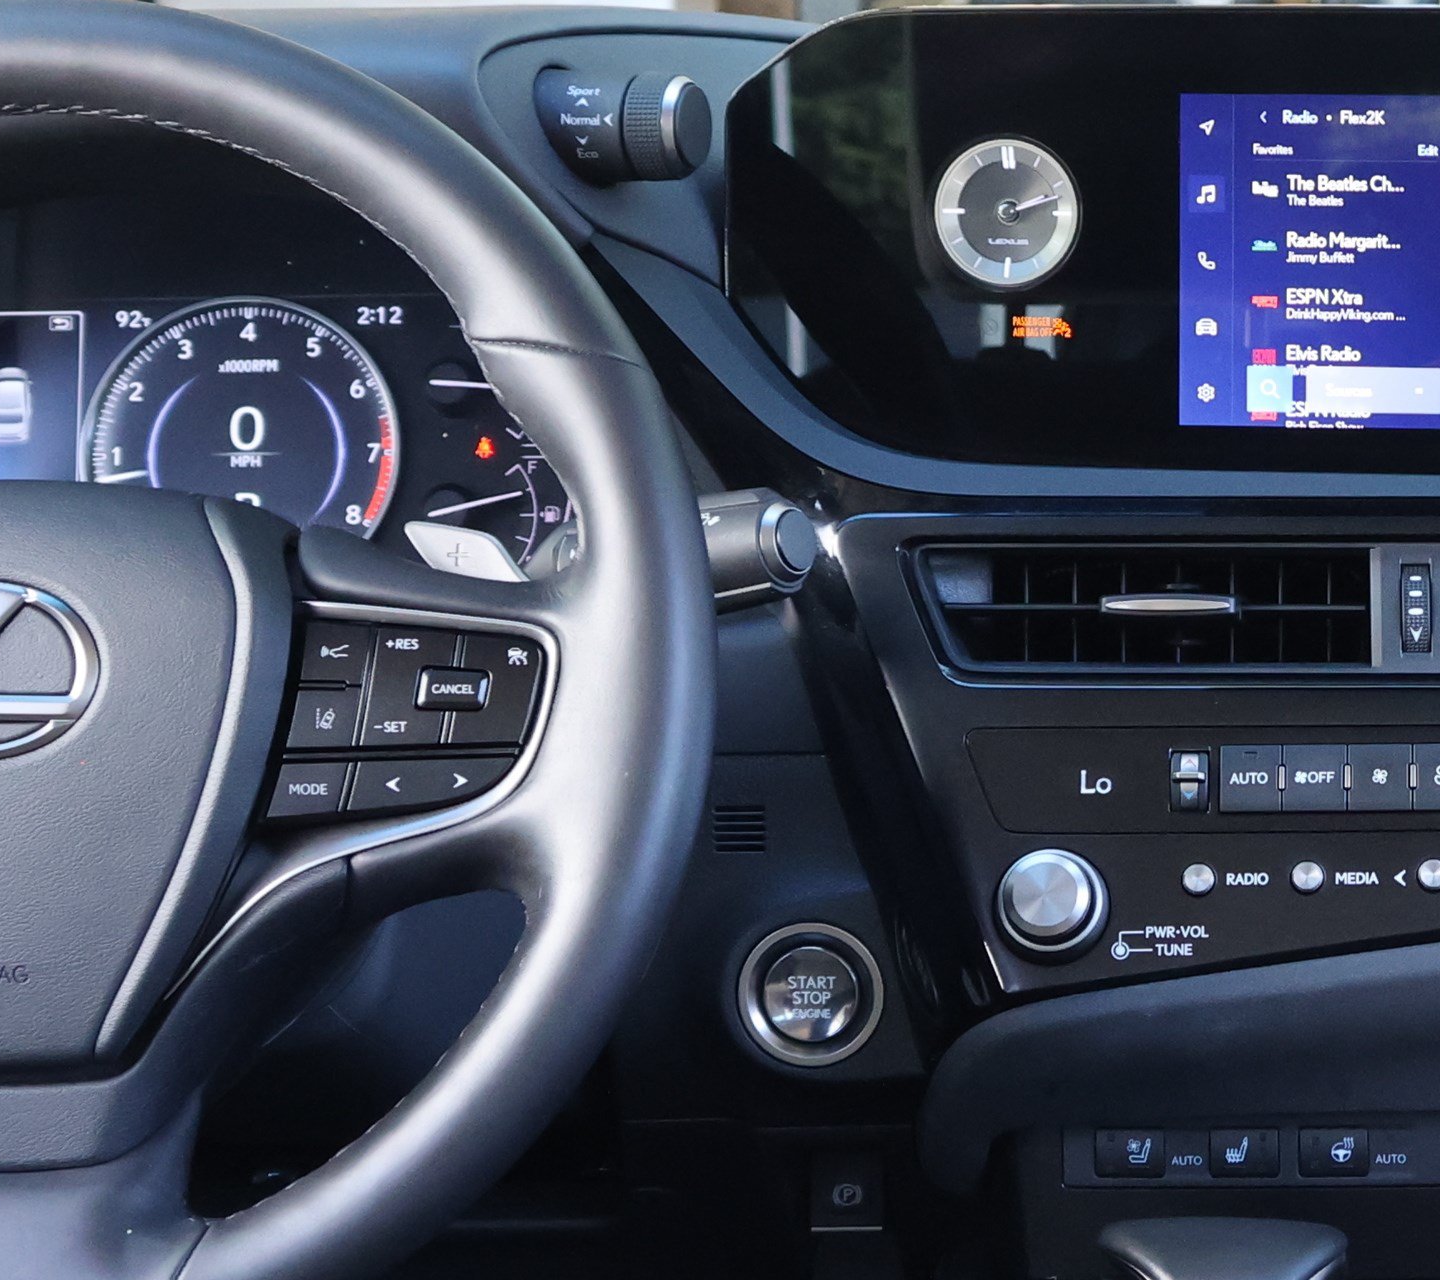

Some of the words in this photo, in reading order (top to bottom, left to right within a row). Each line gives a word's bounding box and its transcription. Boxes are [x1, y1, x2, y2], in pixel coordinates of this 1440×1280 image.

[566, 84, 602, 98] Sport
[560, 112, 601, 126] Normal
[1282, 109, 1319, 124] Radio
[1340, 109, 1386, 125] Flex2K
[1252, 143, 1294, 156] Favorites
[1417, 143, 1439, 157] Edit
[1286, 174, 1315, 192] The
[1317, 174, 1368, 192] Beatles
[1287, 194, 1307, 207] The
[1308, 194, 1344, 207] Beatles
[987, 237, 1030, 246] LEXUS
[1286, 231, 1327, 248] Radio
[1286, 252, 1318, 265] Jimmy
[1319, 252, 1355, 264] Buffett
[1286, 287, 1330, 305] ESPN
[1330, 288, 1363, 306] Xtra
[356, 306, 404, 326] 2:12
[1012, 316, 1051, 327] PASSENGER
[1286, 308, 1394, 323] DrinkHappyViking.com
[239, 322, 258, 342] 4
[177, 341, 194, 360] 3
[306, 338, 322, 357] 5
[1286, 344, 1319, 361] Elvis
[1320, 345, 1362, 362] Radio
[218, 359, 279, 373] x1000RPM
[128, 382, 144, 402] 2
[348, 378, 365, 399] 6
[229, 405, 266, 451] 0
[111, 446, 123, 466] 1
[366, 442, 381, 463] 7
[230, 456, 263, 468] MPH
[527, 461, 538, 474] F
[345, 504, 362, 525] 8
[431, 682, 475, 696] CANCEL
[1079, 768, 1113, 795] Lo
[1229, 771, 1269, 785] AUTO
[1307, 770, 1335, 784] OFF
[288, 782, 328, 796] MODE
[1226, 872, 1269, 887] RADIO
[1335, 871, 1379, 886] MEDIA
[1155, 943, 1193, 957] TUNE
[787, 976, 837, 989] START
[792, 991, 832, 1005] STOP
[790, 1008, 832, 1019] ENGINE
[1171, 1155, 1203, 1167] AUTO
[1375, 1153, 1407, 1165] AUTO
